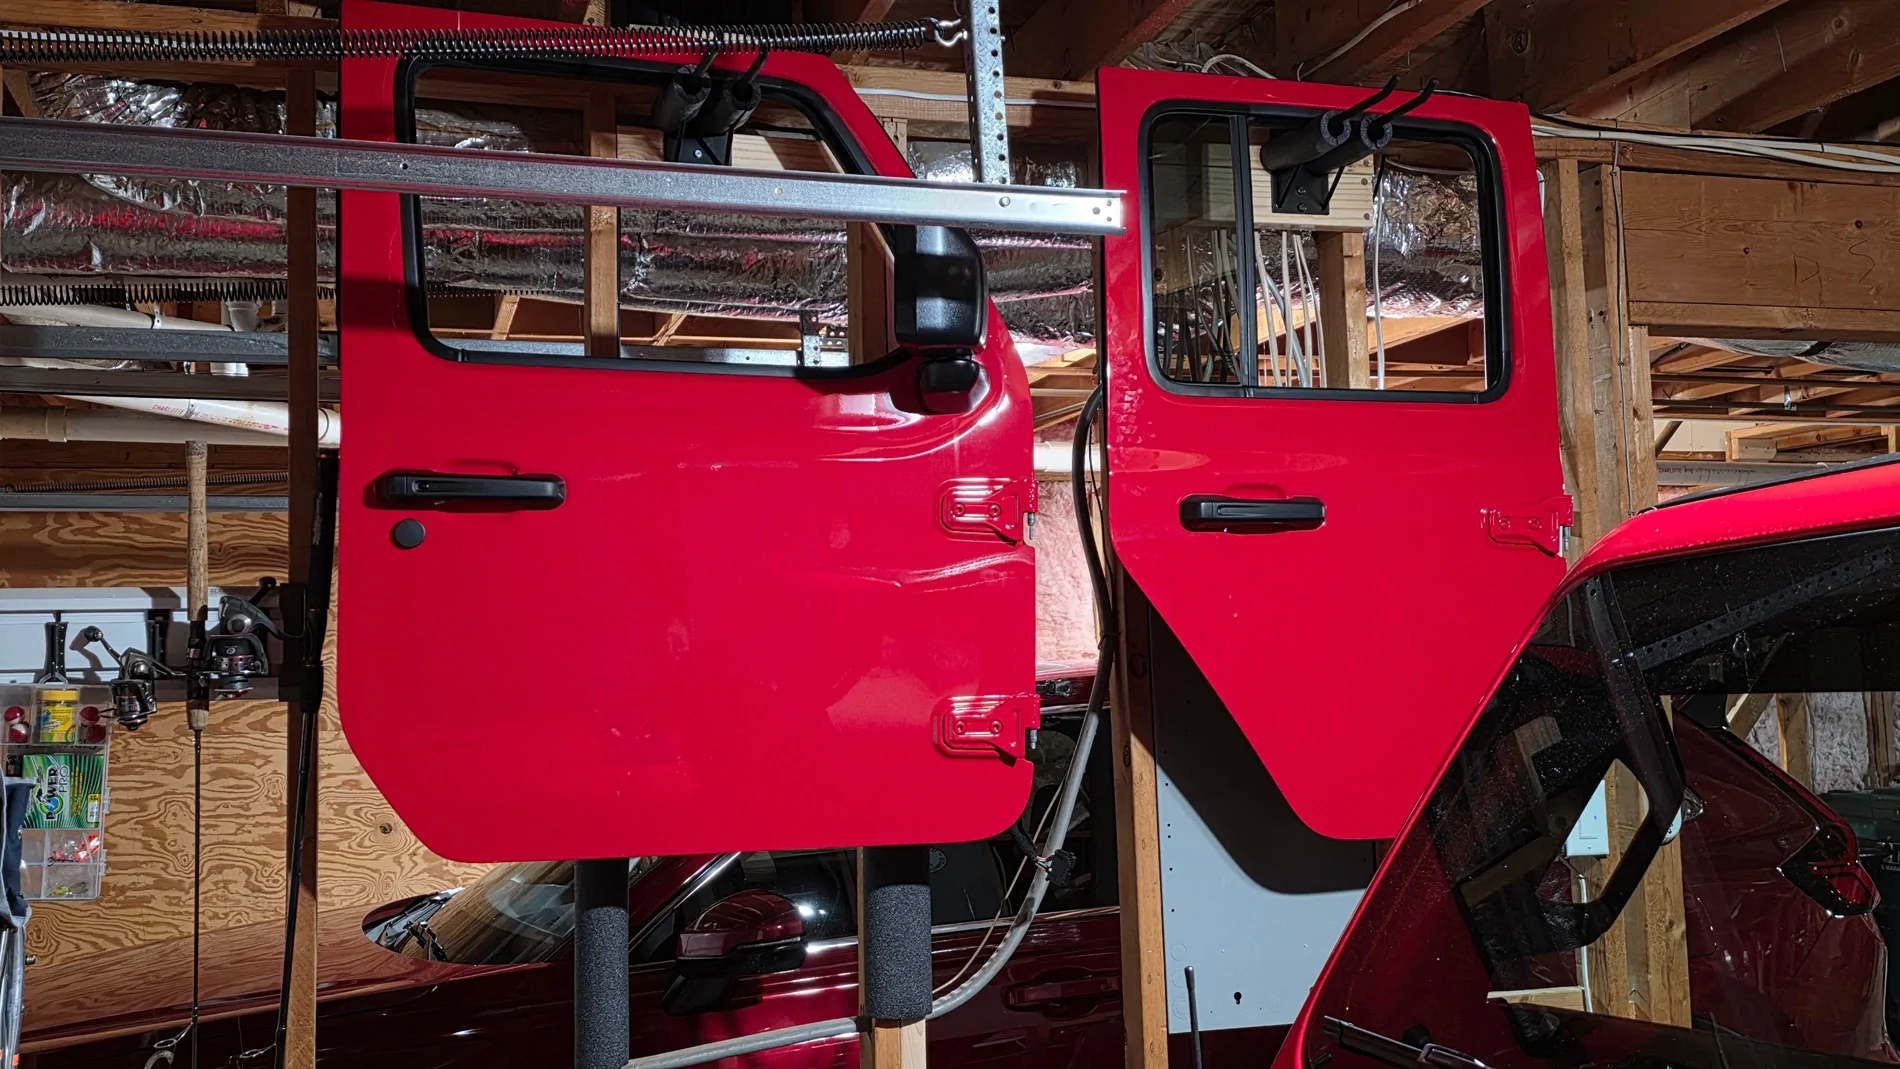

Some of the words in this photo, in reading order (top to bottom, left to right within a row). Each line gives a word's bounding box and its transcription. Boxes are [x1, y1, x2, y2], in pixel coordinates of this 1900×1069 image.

[152, 404, 185, 415] CHARLOTTE
[44, 766, 60, 820] POWER
[59, 765, 69, 793] PRO
